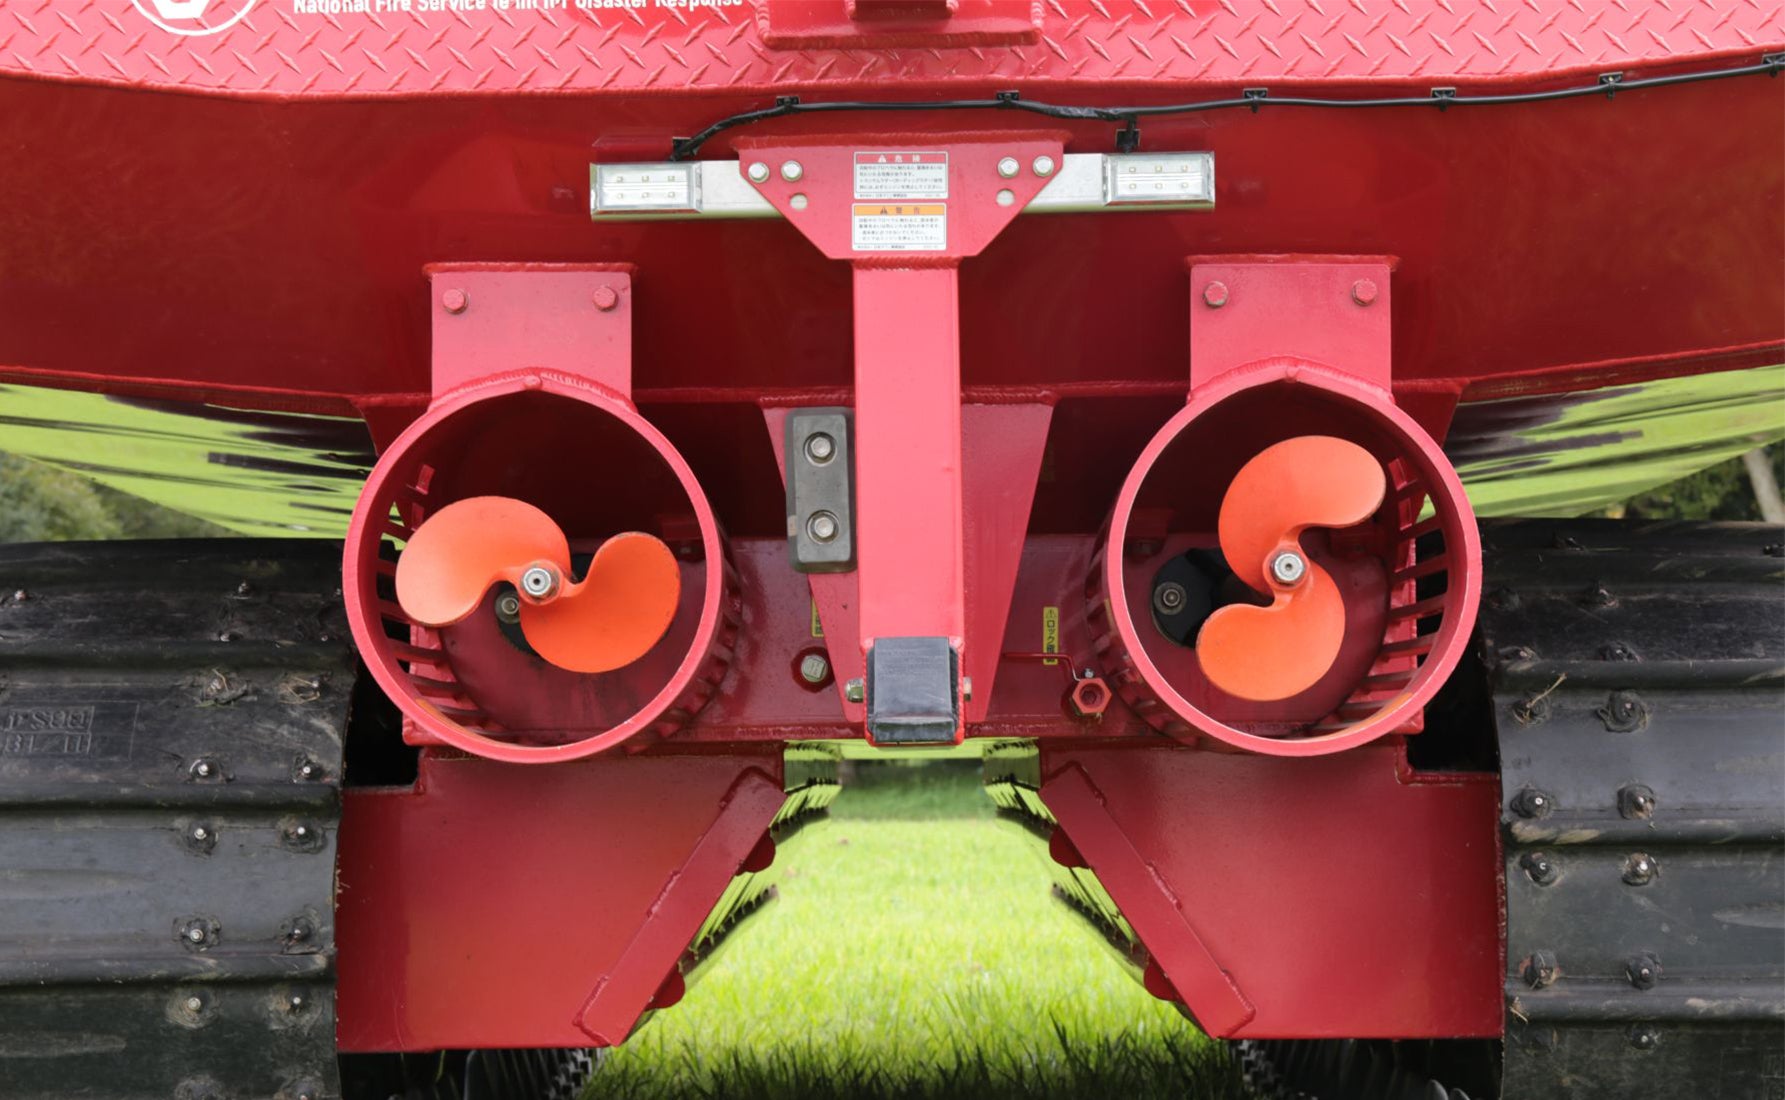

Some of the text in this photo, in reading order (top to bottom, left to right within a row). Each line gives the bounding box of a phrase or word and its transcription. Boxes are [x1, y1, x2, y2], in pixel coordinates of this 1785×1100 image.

[293, 0, 370, 14] National
[375, 0, 411, 12] Fire
[417, 0, 486, 12] Service
[1046, 619, 1056, 663] ロック
